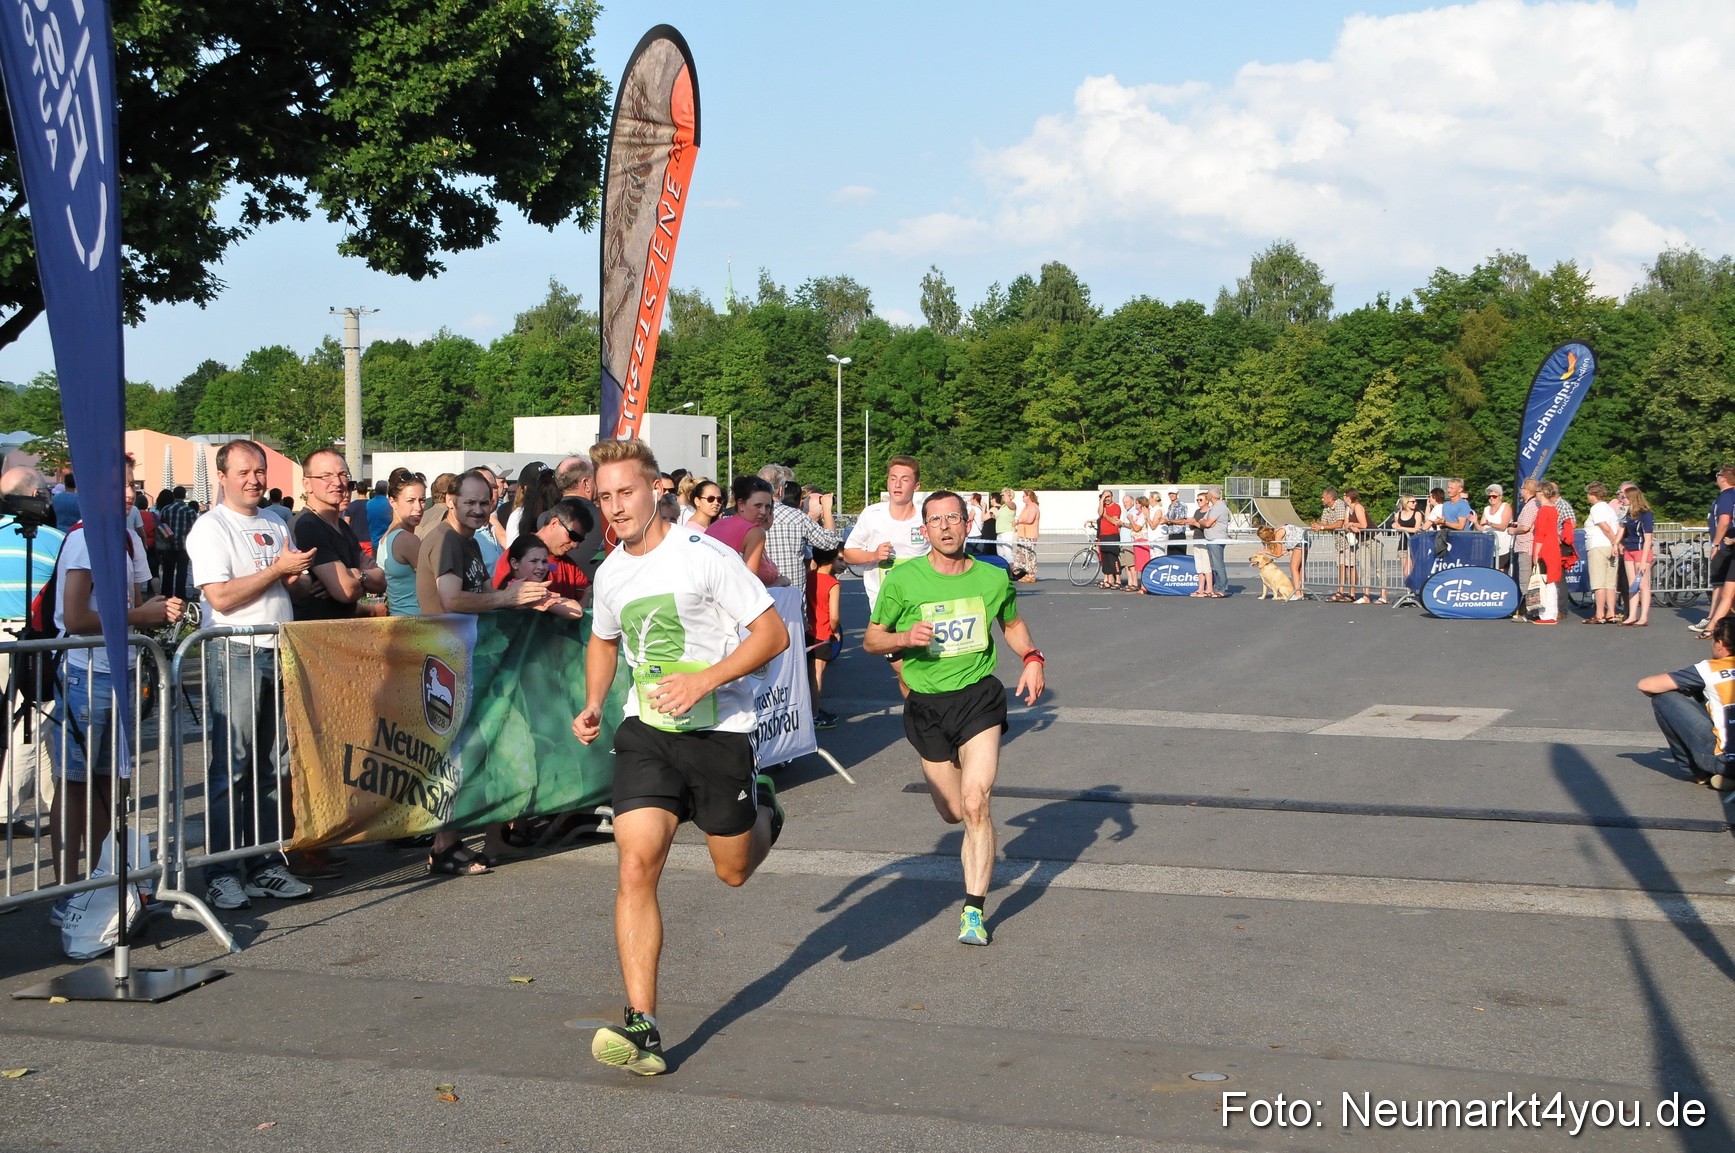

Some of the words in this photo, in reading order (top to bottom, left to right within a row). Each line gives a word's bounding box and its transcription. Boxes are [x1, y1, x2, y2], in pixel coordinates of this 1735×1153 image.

[1521, 380, 1572, 460] Frischmann
[1446, 589, 1508, 601] Fischer
[934, 617, 977, 644] 567
